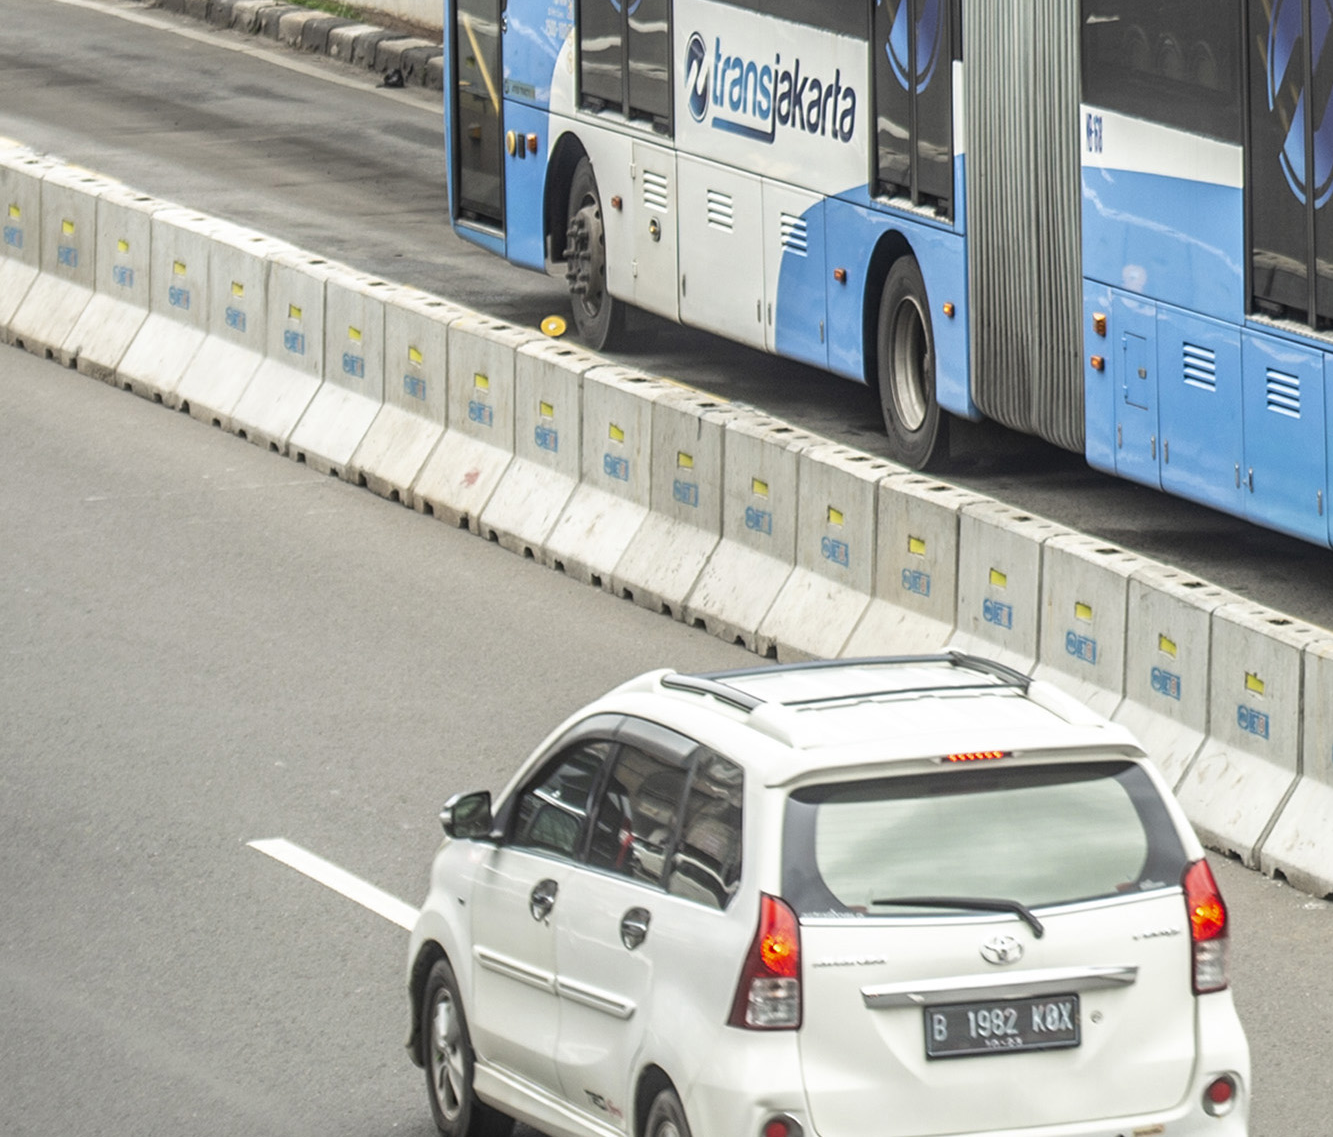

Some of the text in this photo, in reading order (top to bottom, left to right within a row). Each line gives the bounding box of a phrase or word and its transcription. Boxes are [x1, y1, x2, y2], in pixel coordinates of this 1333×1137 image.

[712, 36, 857, 144] transjakarta
[933, 1014, 947, 1042] B
[968, 1008, 1018, 1039] 1982
